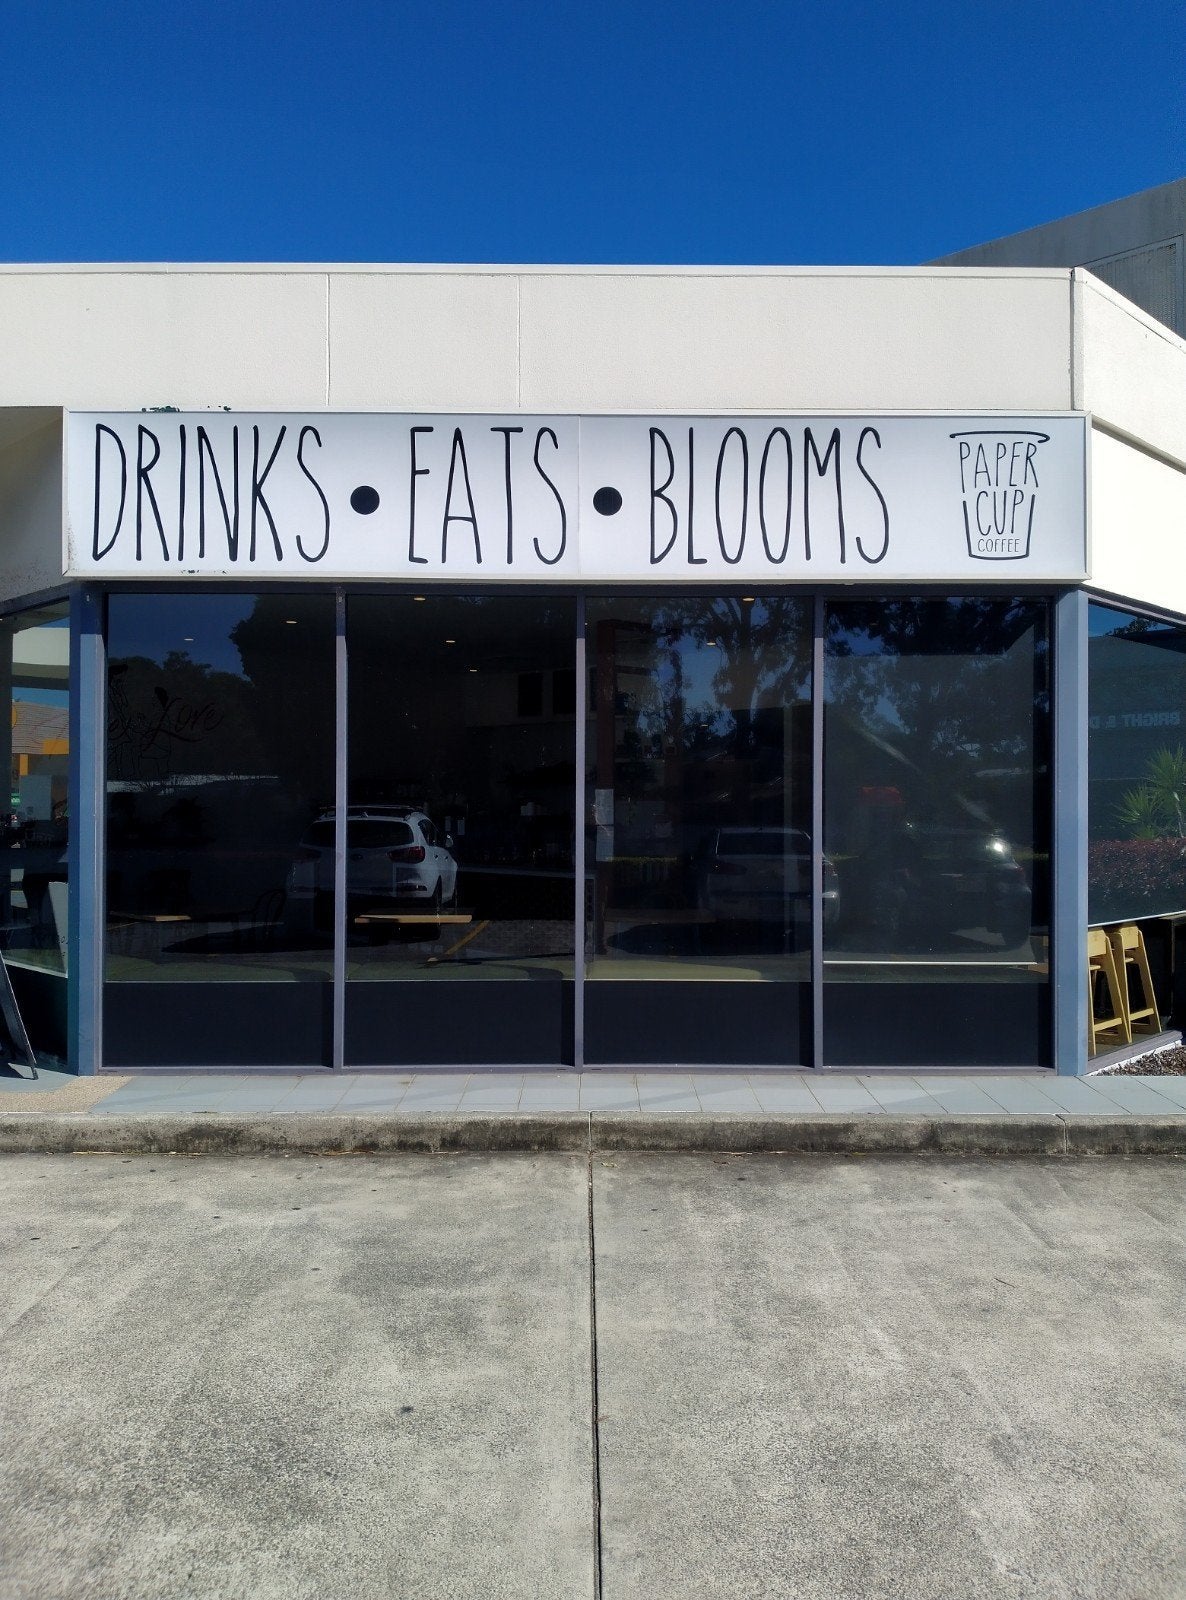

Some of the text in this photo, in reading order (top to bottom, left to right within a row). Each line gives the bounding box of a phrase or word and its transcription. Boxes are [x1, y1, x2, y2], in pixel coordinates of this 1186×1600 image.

[959, 441, 1039, 494] PAPER
[92, 423, 890, 565] DRINKS EATS BLOOMS
[976, 488, 1025, 536] CUP
[977, 538, 1020, 553] COFFEE
